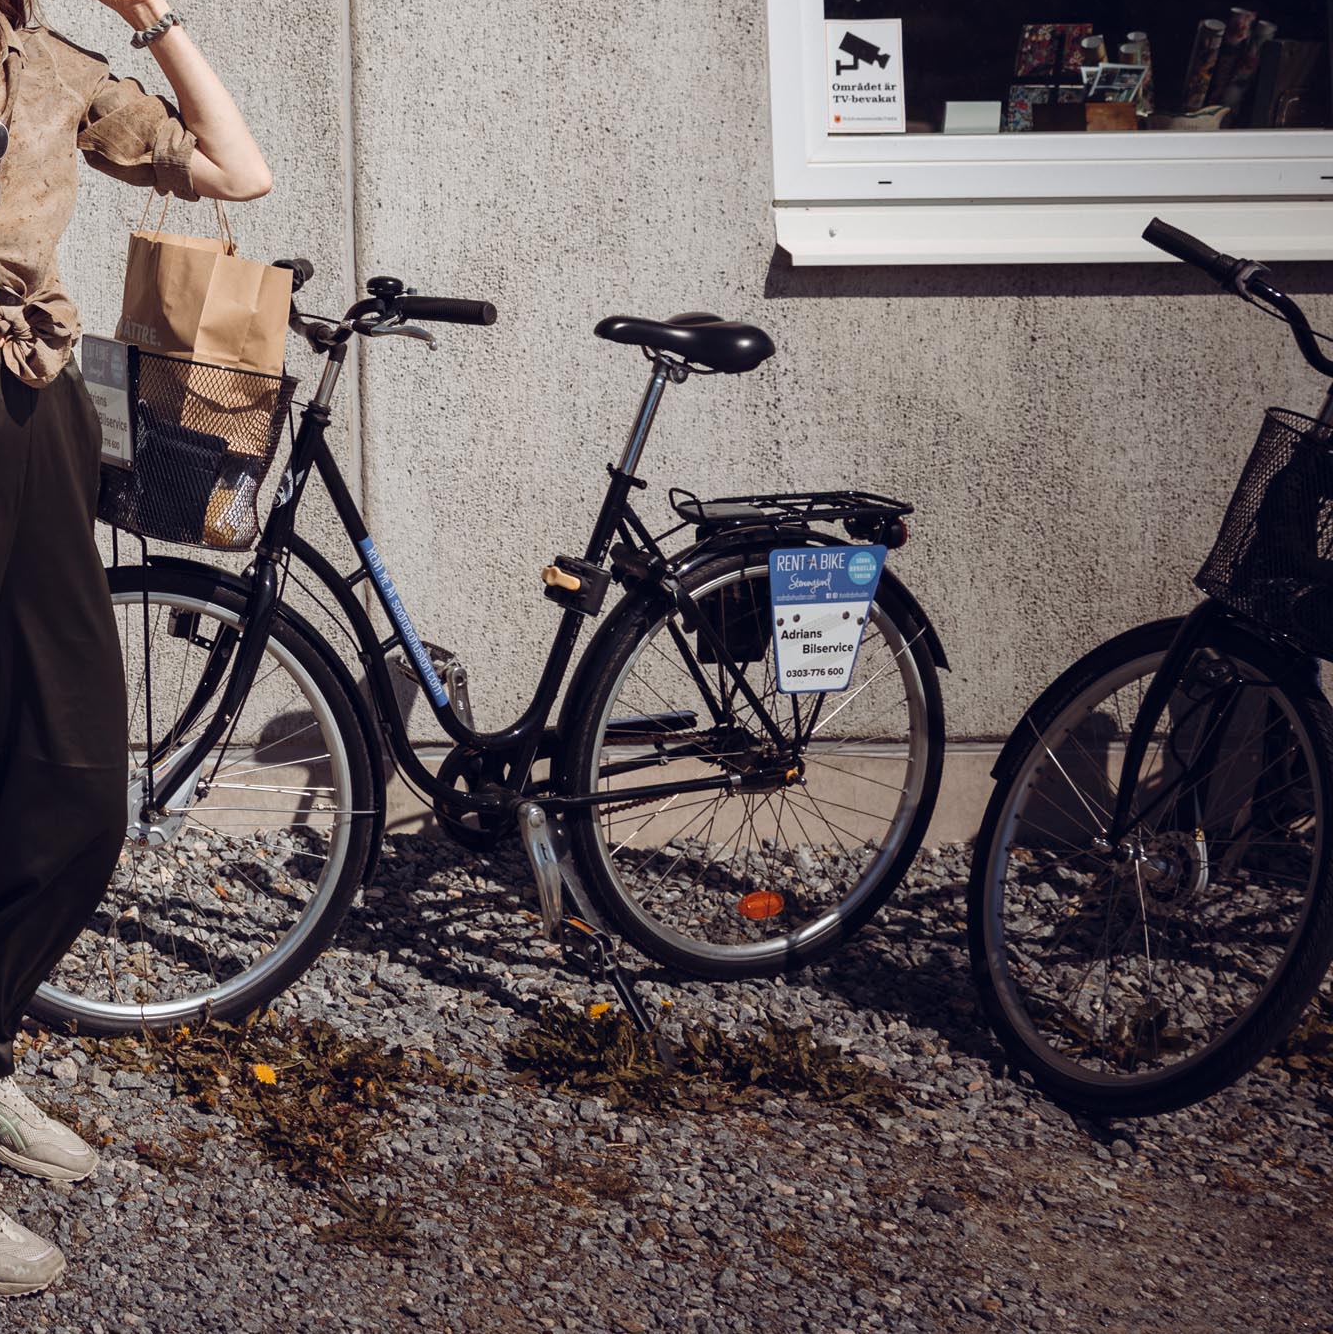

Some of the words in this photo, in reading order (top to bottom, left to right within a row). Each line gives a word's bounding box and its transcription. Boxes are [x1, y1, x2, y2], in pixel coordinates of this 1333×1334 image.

[832, 82, 882, 92] Området
[884, 82, 897, 91] är
[833, 95, 897, 103] TV-bevakat
[118, 315, 161, 346] ÄTTRE.
[776, 554, 807, 572] RENT
[809, 554, 818, 570] A
[820, 552, 846, 570] BIKE
[377, 573, 391, 588] ME
[780, 629, 823, 640] Adrians
[802, 643, 854, 654] Bilservice
[786, 668, 826, 678] 0303-776
[827, 668, 844, 676] 600
